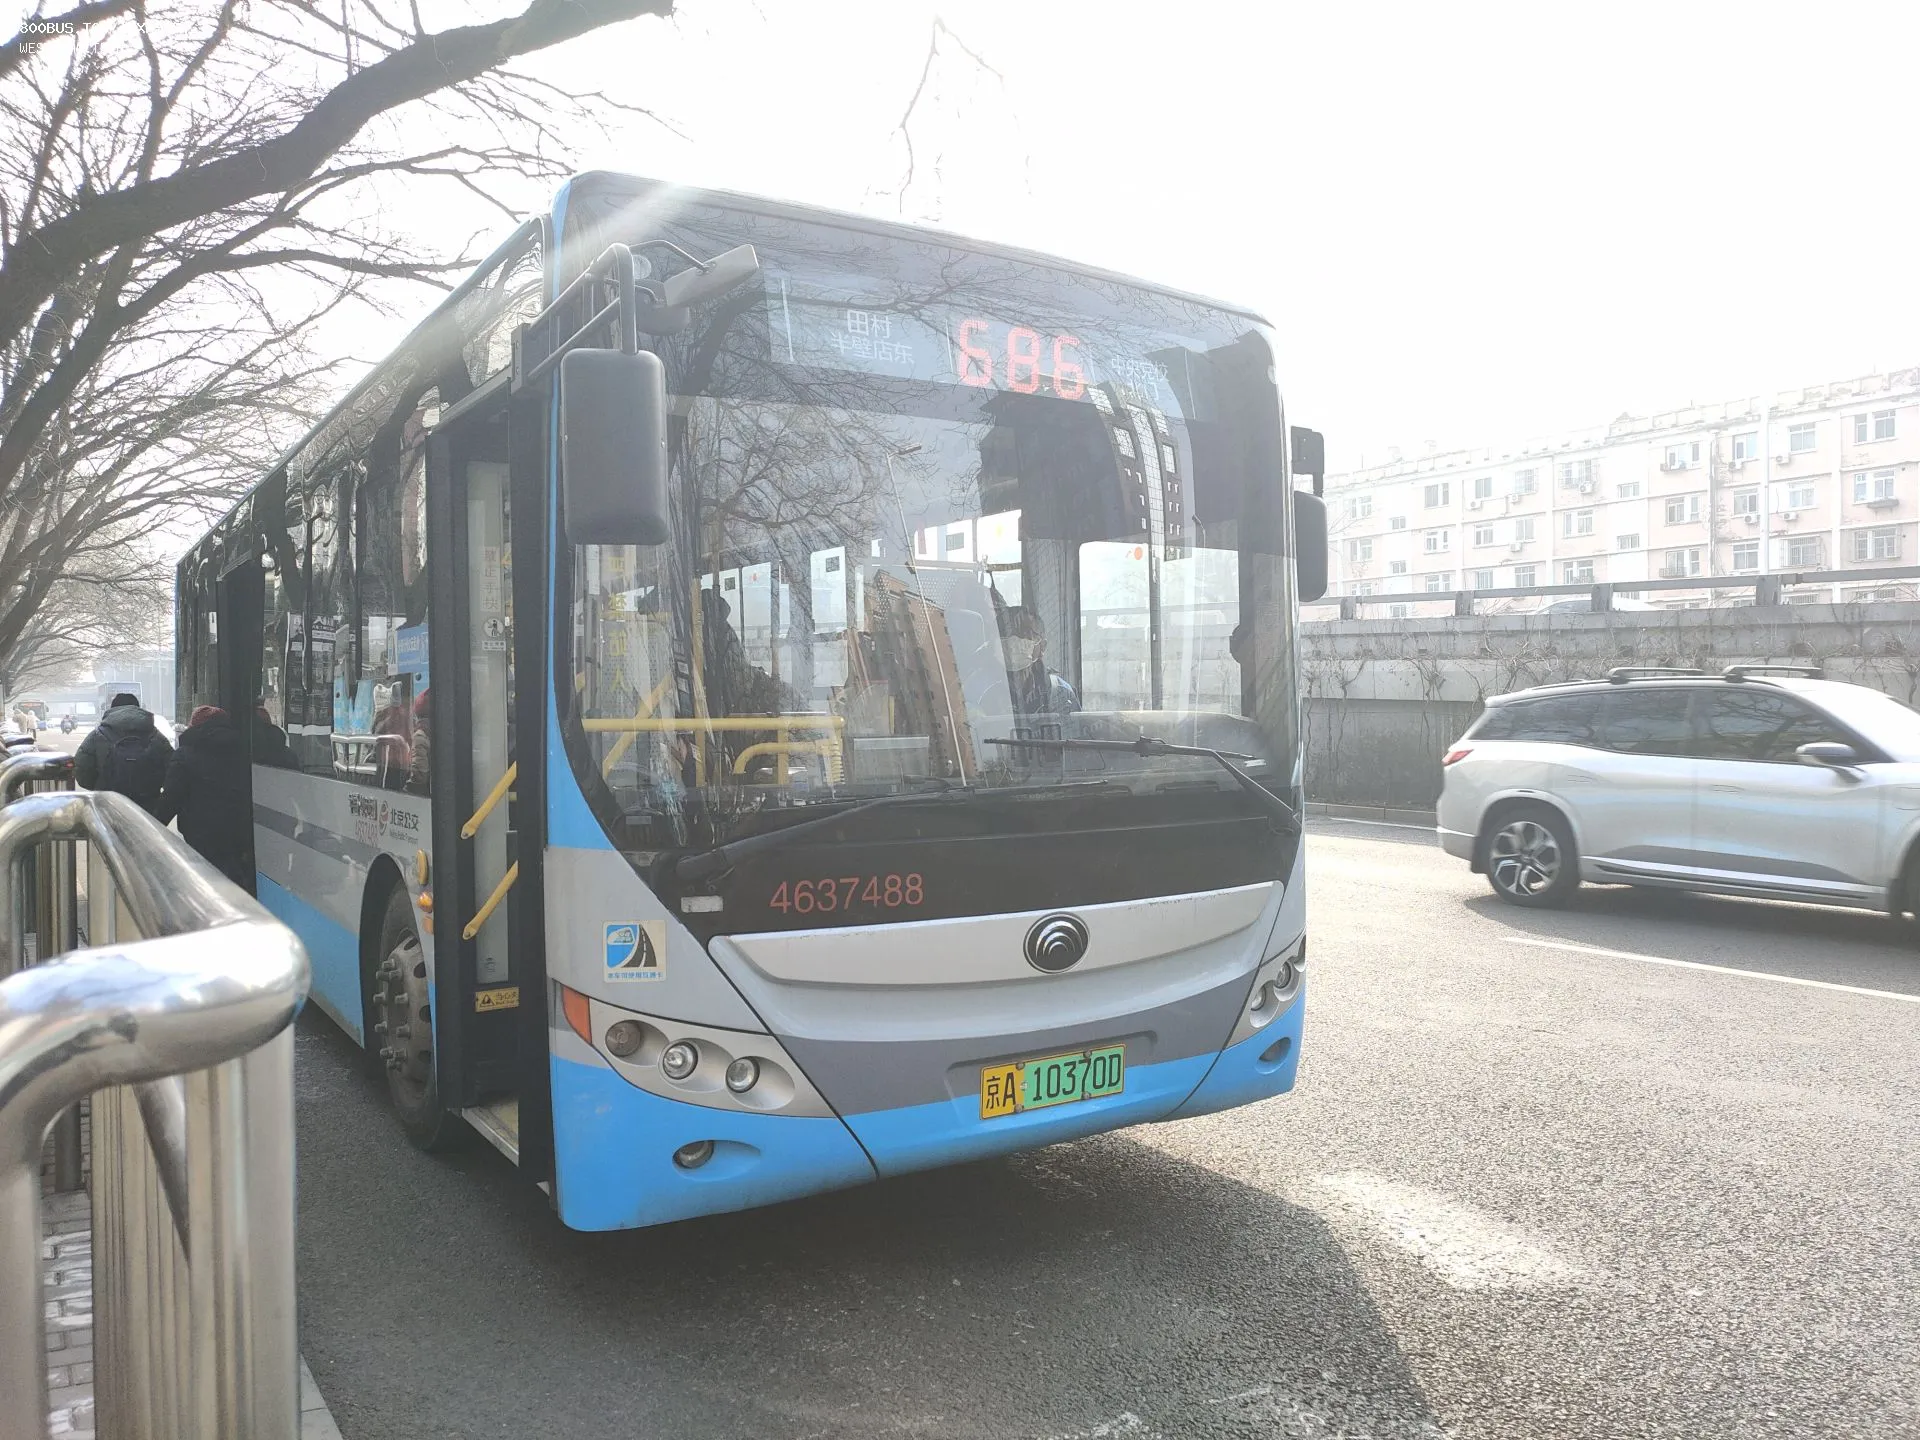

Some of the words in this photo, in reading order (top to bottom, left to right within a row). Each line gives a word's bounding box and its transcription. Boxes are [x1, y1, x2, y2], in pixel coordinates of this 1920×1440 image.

[847, 309, 892, 338] 田村
[830, 331, 915, 364] 半壁店东
[957, 319, 1085, 400] 686
[1111, 355, 1168, 381] 中央党校
[390, 808, 419, 832] 北京公交
[769, 873, 924, 915] 4637488
[1032, 1053, 1121, 1101] 10370D
